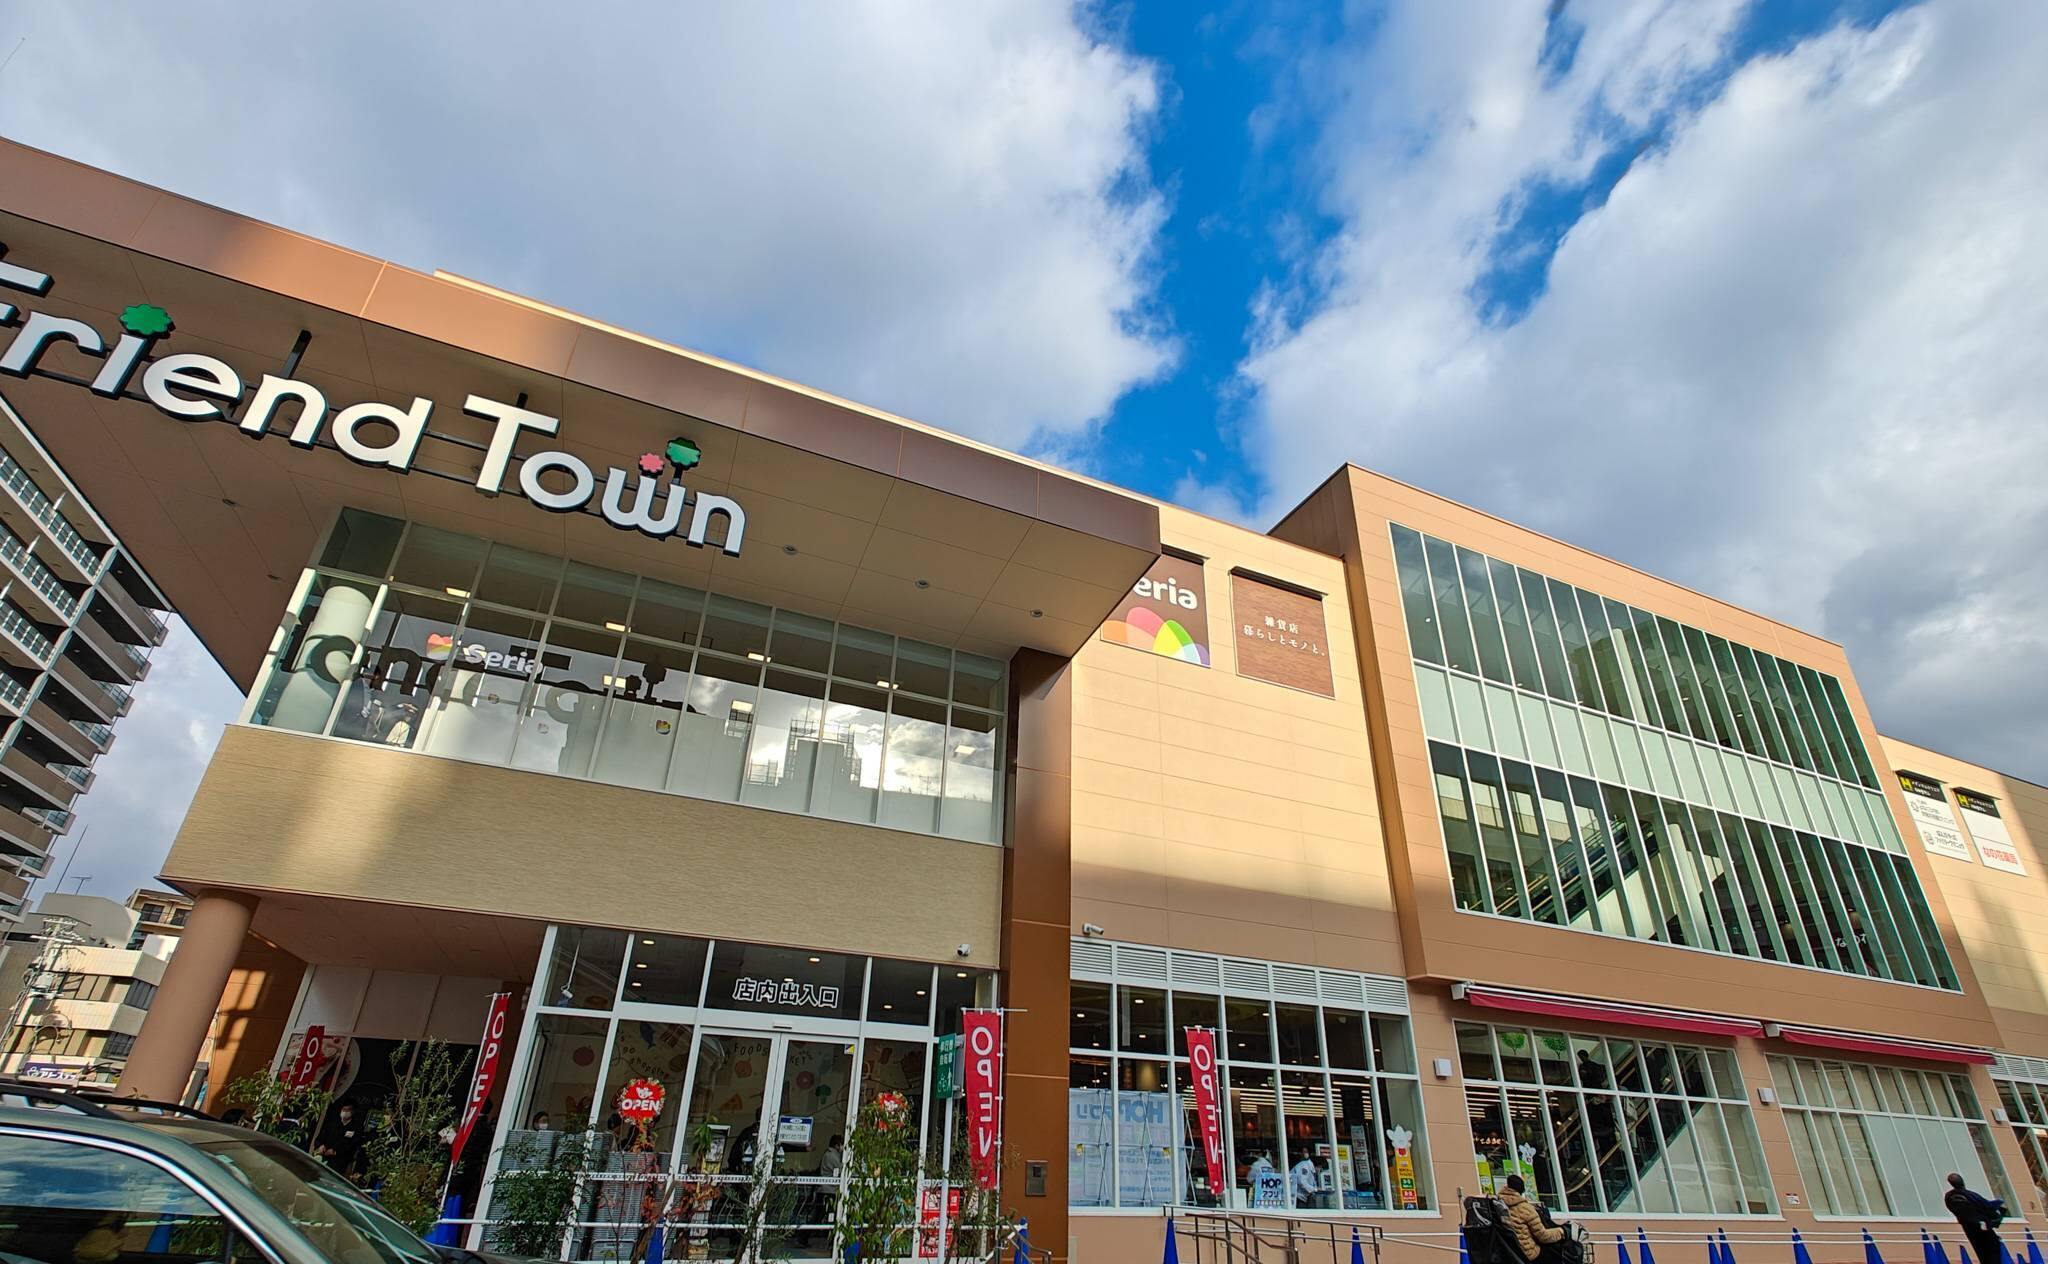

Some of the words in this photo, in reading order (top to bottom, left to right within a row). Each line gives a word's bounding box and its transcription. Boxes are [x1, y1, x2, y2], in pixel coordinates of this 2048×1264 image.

[464, 394, 747, 557] Town
[464, 643, 543, 675] Seria
[732, 977, 839, 1009] 店内出入口
[621, 1098, 661, 1114] OPEN
[1261, 1178, 1282, 1189] HOP
